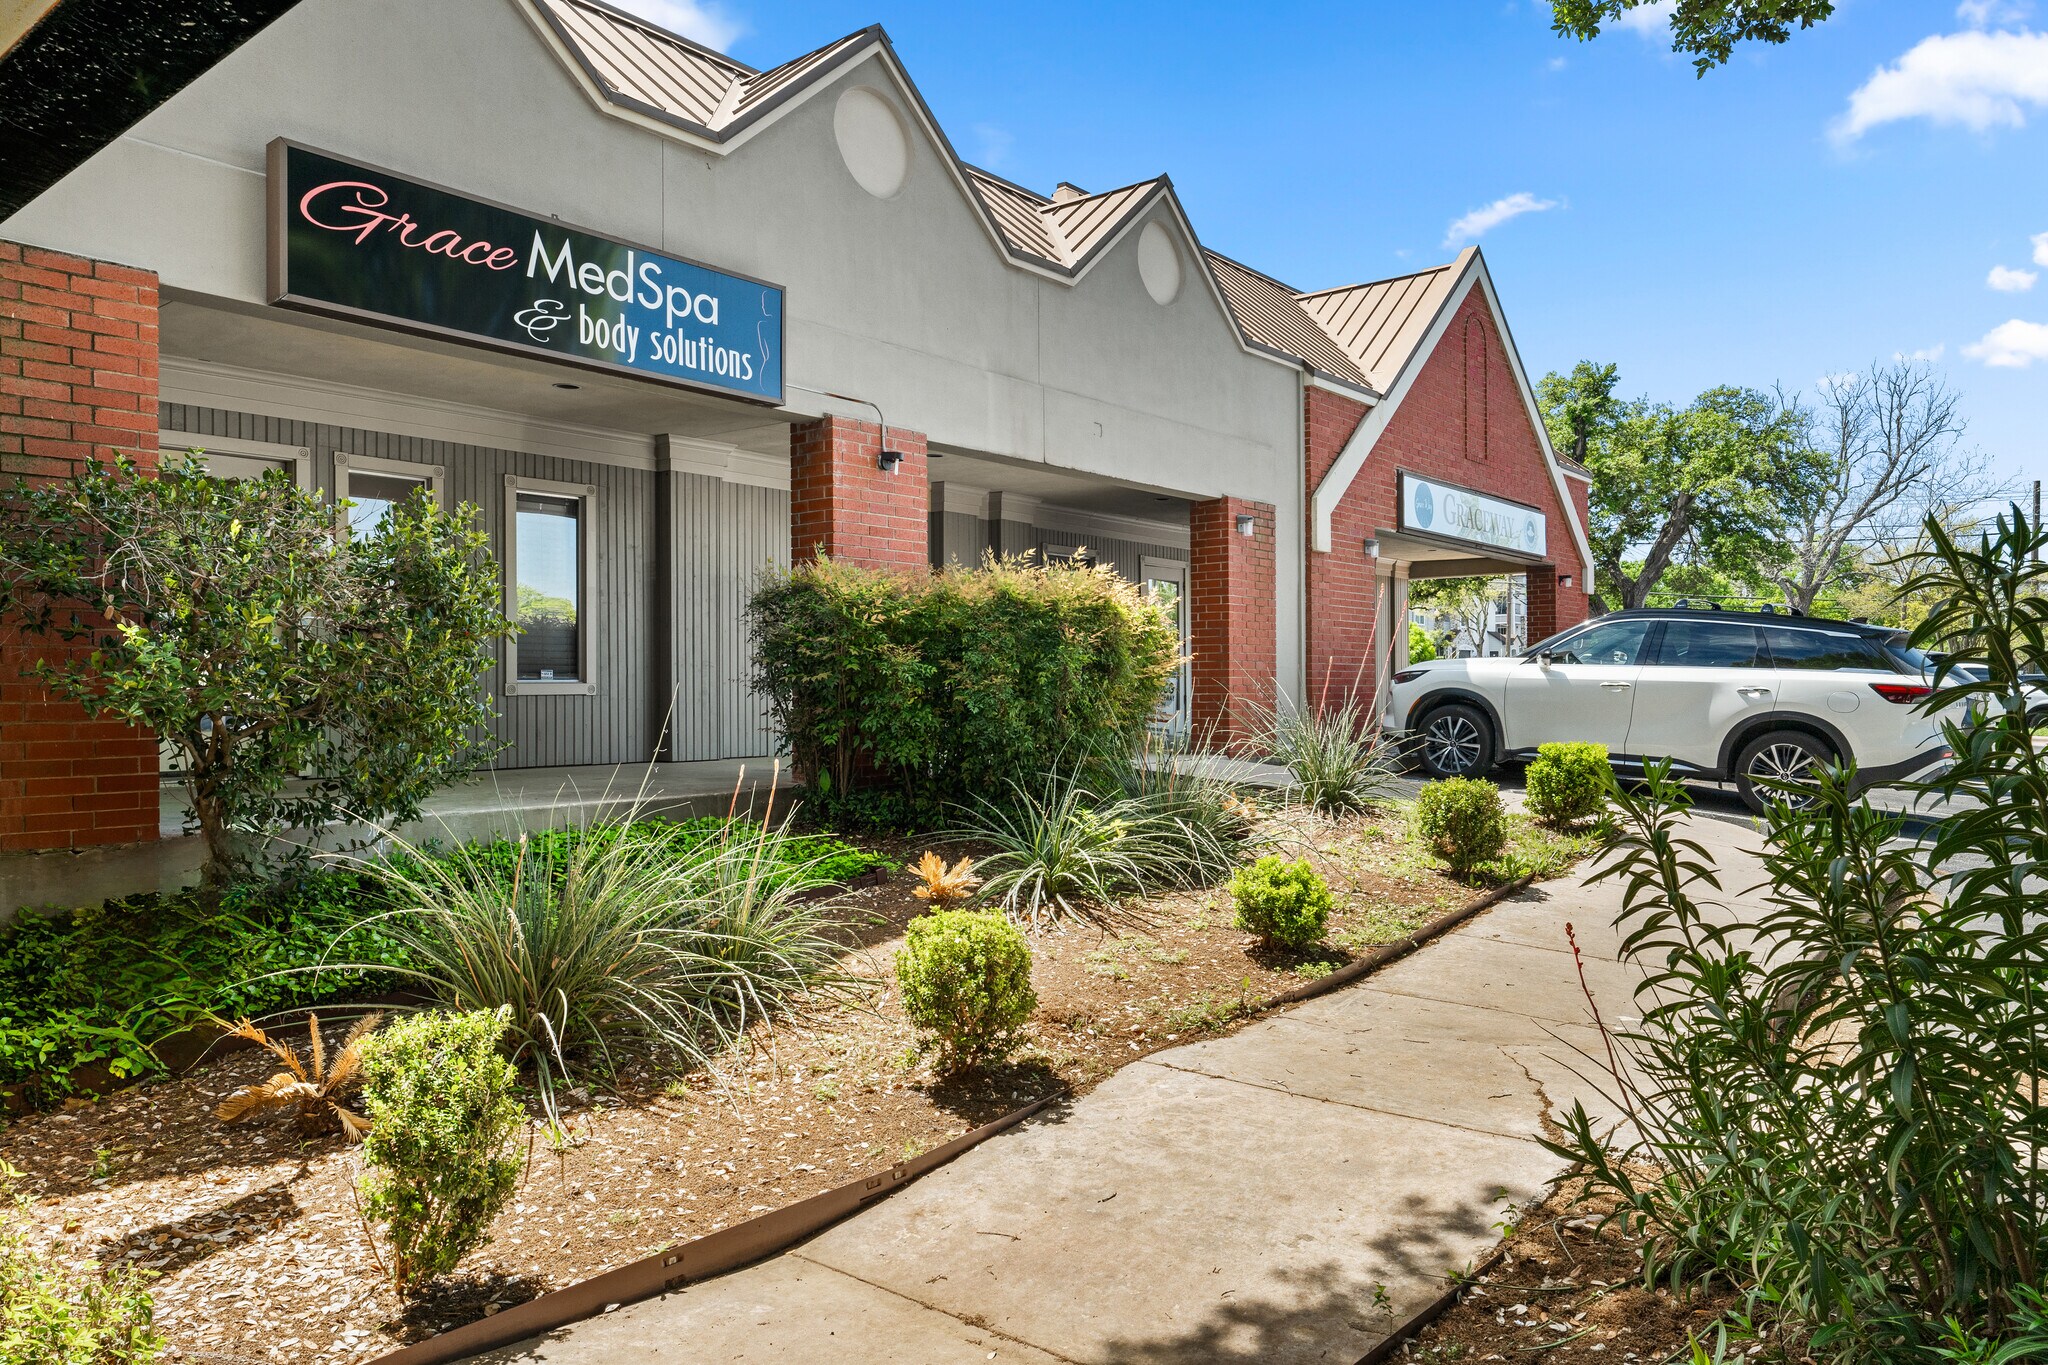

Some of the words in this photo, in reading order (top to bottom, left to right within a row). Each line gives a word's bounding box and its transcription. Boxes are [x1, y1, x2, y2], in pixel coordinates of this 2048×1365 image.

[300, 180, 518, 271] Grace
[526, 228, 719, 328] MedSpa
[513, 299, 572, 343] &
[579, 303, 640, 363] body
[650, 326, 753, 381] solutions
